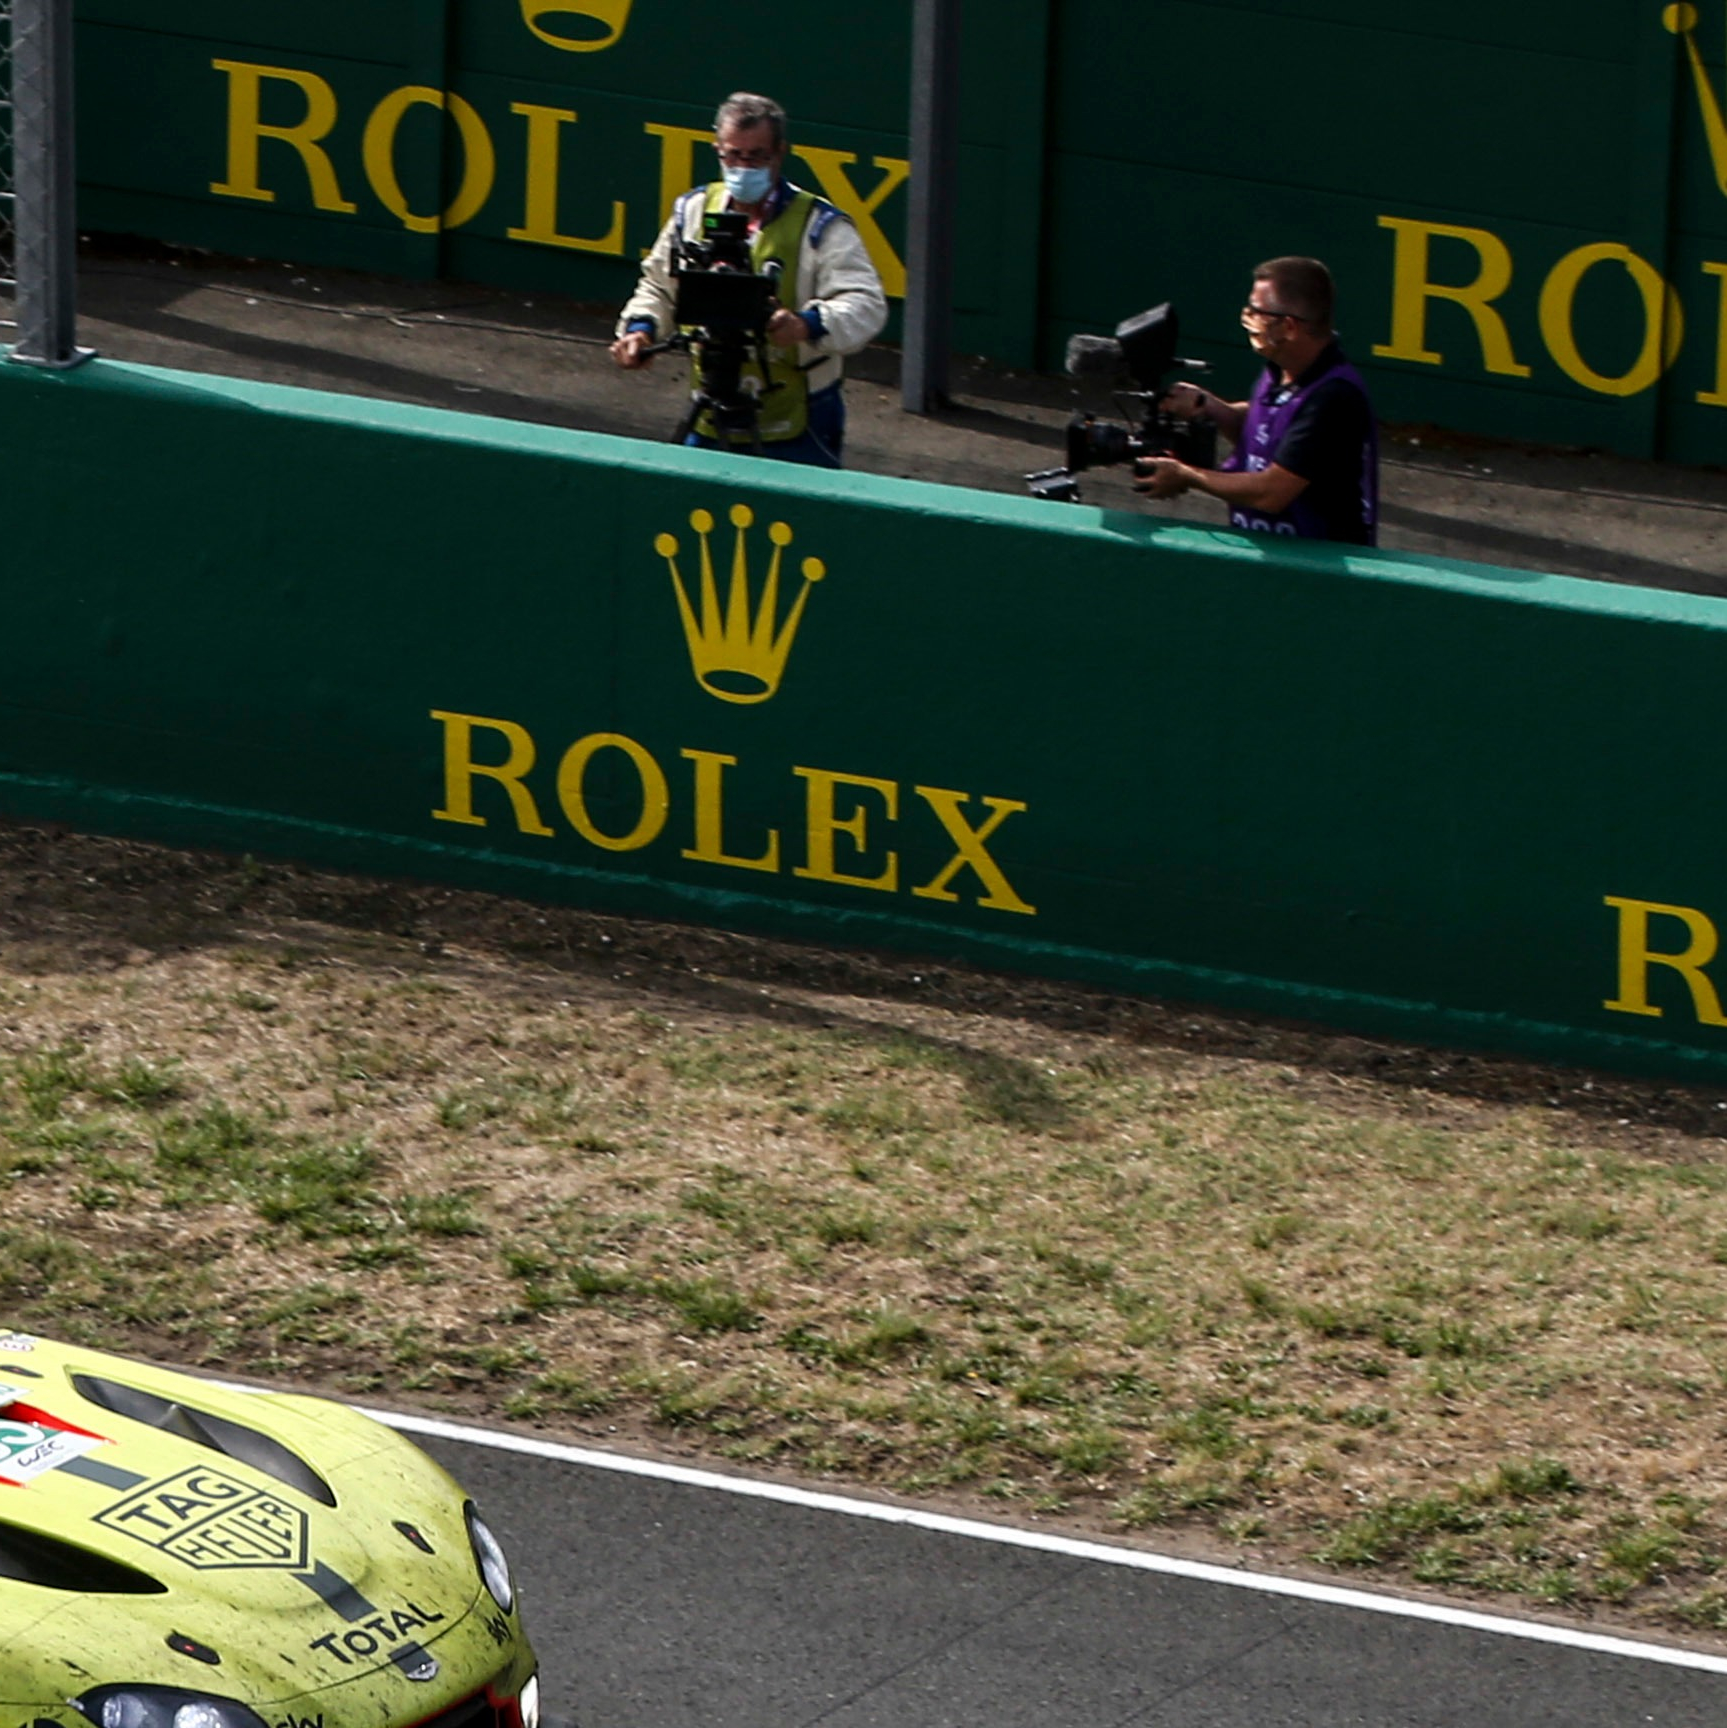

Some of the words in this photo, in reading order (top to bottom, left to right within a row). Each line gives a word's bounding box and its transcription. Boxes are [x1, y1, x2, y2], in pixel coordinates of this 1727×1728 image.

[430, 709, 1036, 916] ROLEX
[116, 1475, 243, 1531] TAG
[173, 1500, 295, 1561] HEUER
[309, 1602, 446, 1665] TOTAL
[486, 1616, 514, 1646] sky
